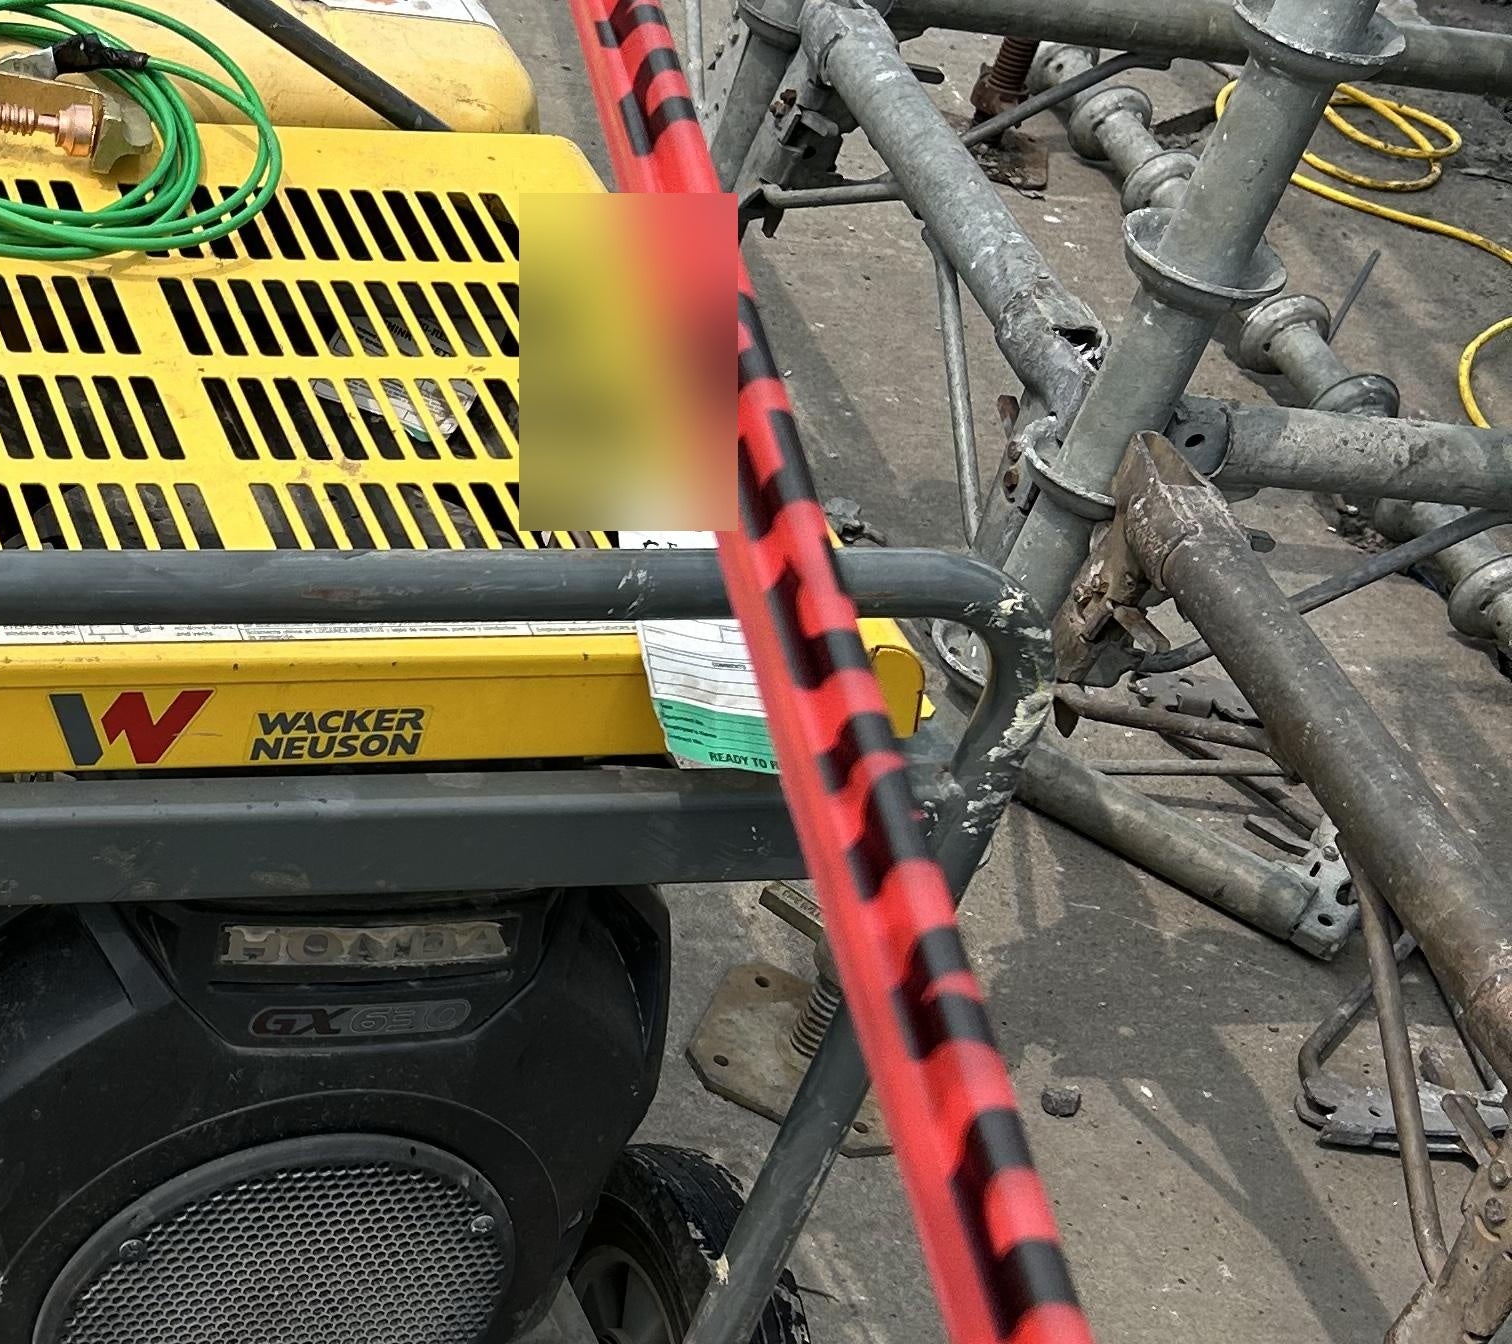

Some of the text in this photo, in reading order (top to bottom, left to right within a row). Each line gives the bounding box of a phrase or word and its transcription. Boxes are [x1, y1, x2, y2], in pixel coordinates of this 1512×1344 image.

[256, 707, 426, 736] WACKER
[248, 731, 425, 761] NEUSON
[708, 751, 750, 766] READY
[750, 756, 768, 769] TO
[225, 924, 507, 963] HONDA
